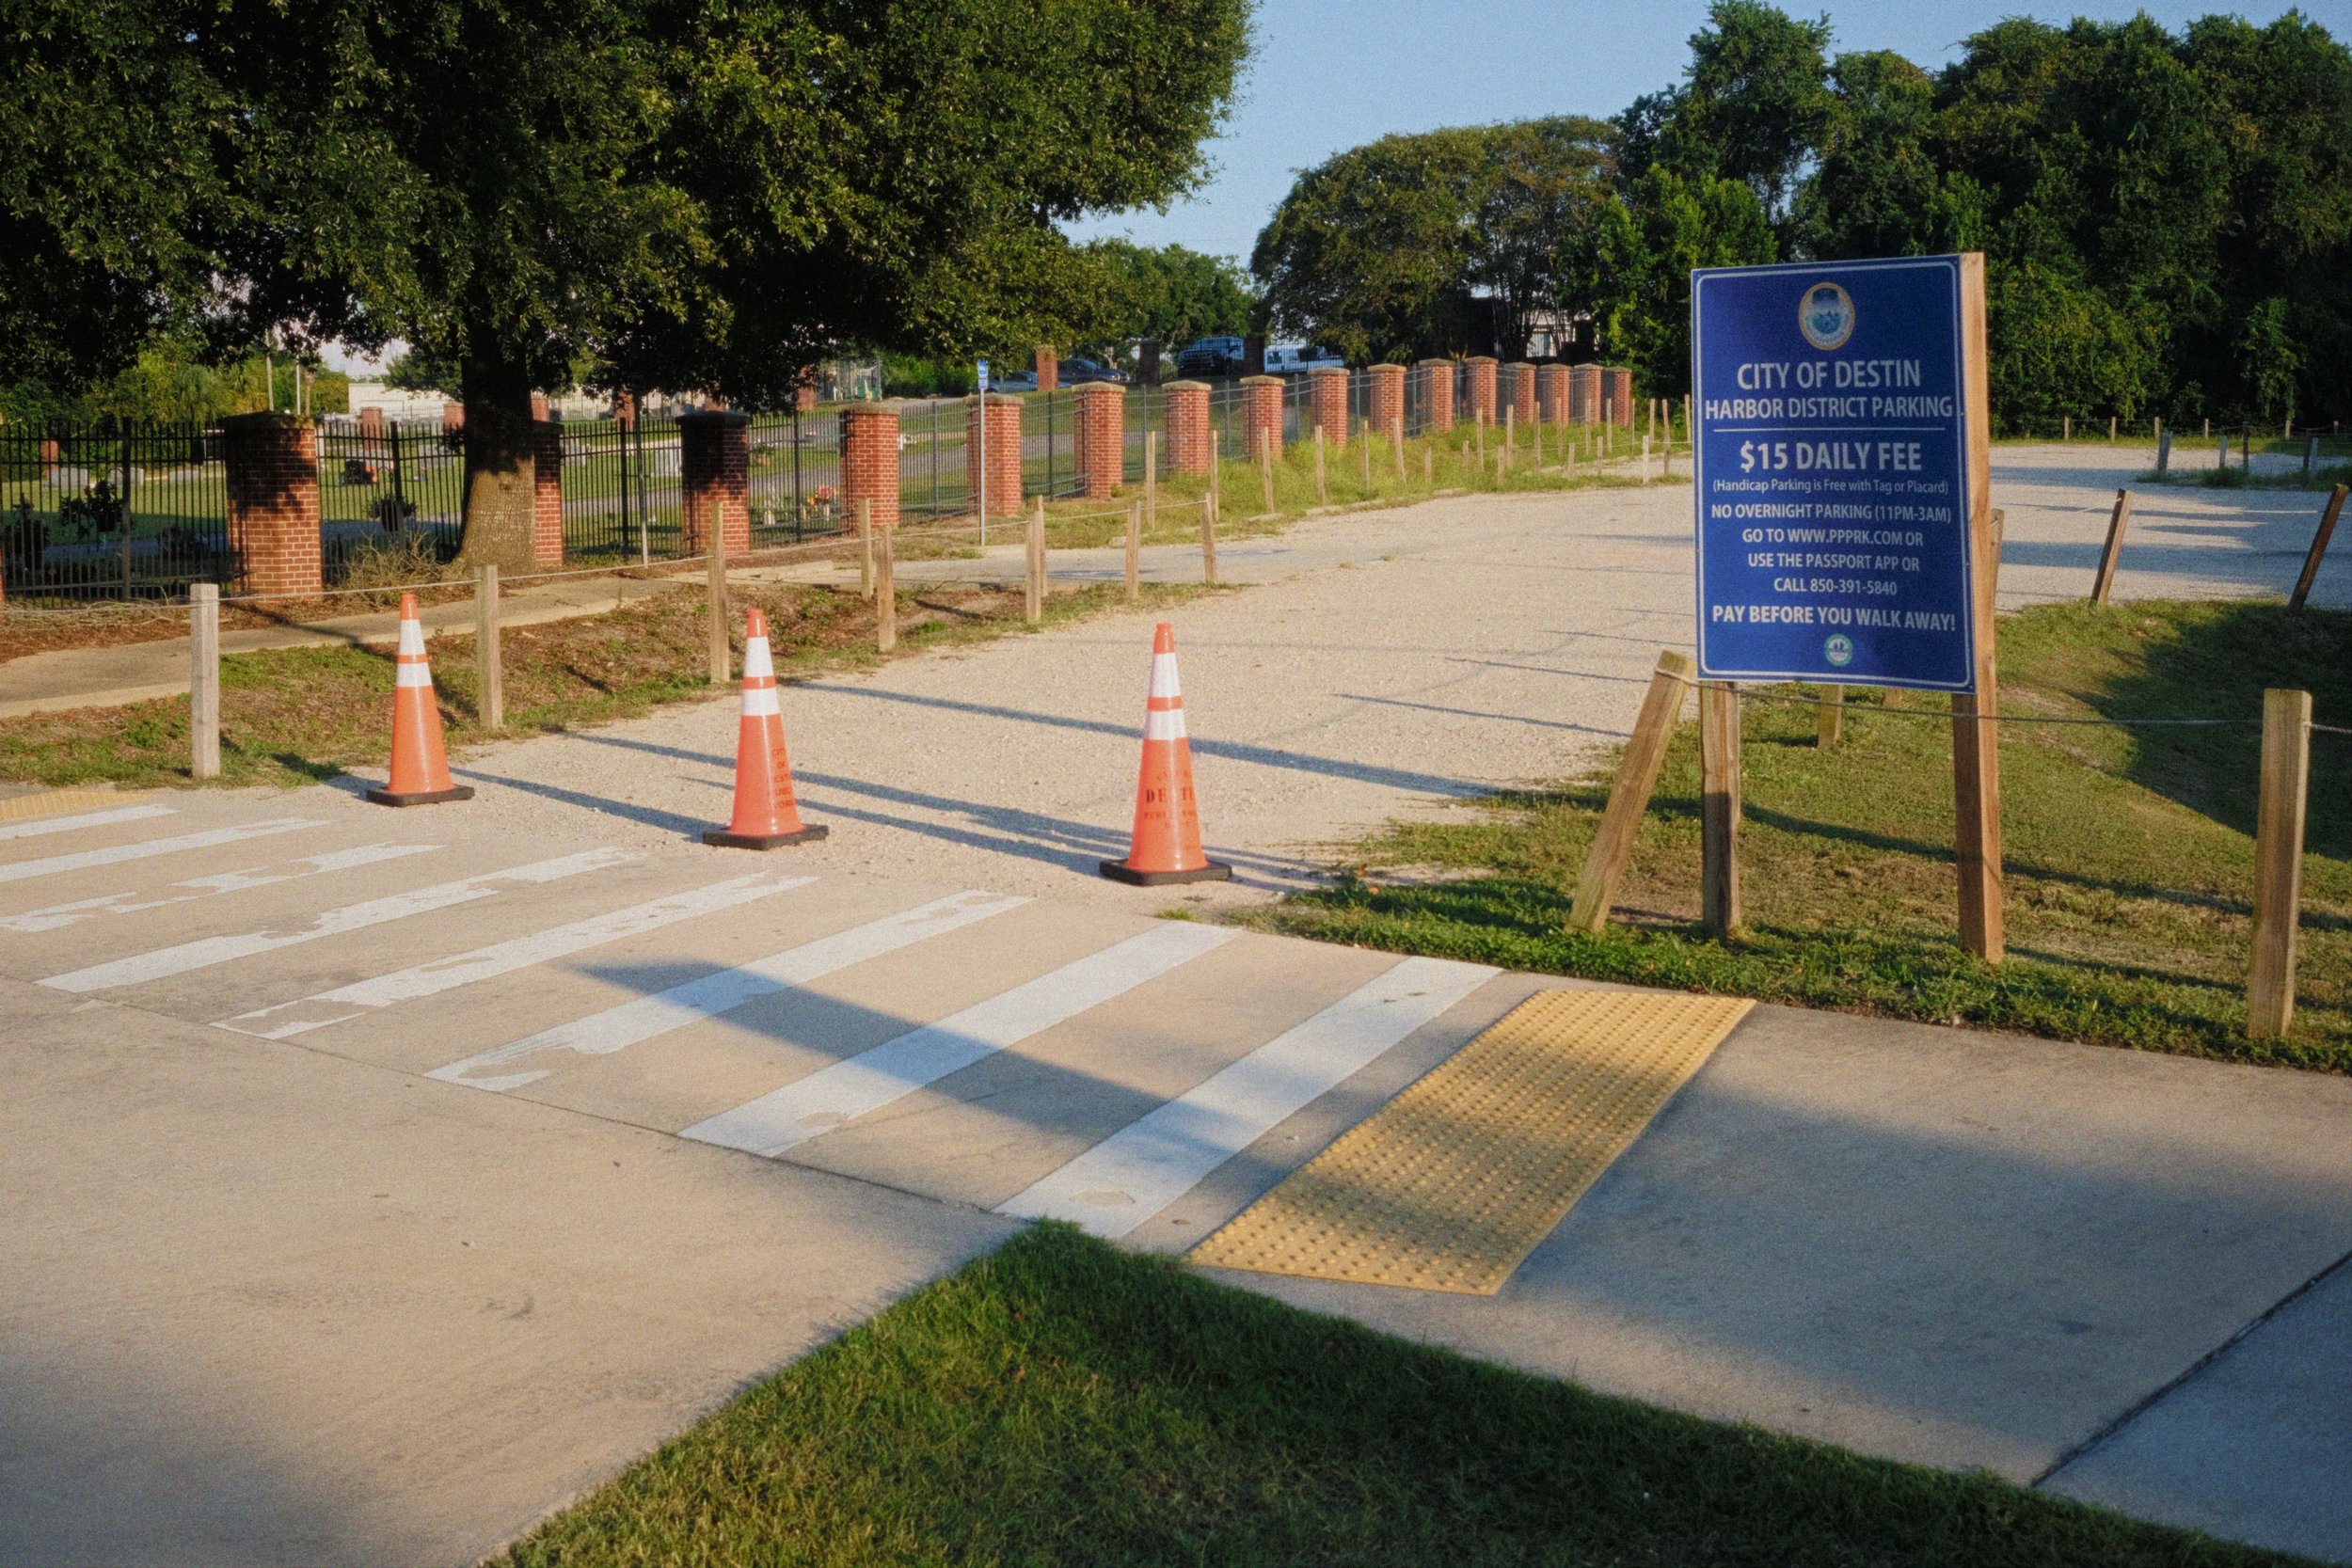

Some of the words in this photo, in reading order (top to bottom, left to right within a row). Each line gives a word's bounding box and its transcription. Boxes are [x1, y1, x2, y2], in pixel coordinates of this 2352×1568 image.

[1737, 362, 1790, 389] CITY
[1796, 361, 1829, 388] OF
[1835, 359, 1921, 388] DESTIN
[1705, 399, 1784, 420] HARBOR
[1788, 397, 1867, 418] DISTRICT
[1872, 396, 1953, 418] PARKING
[1740, 440, 1788, 473] $15
[1796, 442, 1871, 470] DAILY
[1878, 442, 1922, 470] FEE
[1713, 479, 1769, 494] (Handicap
[1771, 479, 1811, 494] Parking
[1813, 479, 1822, 491] is
[1824, 479, 1847, 492] Free
[1849, 479, 1872, 492] with
[1873, 480, 1892, 495] Tag
[1894, 483, 1906, 493] or
[1907, 480, 1949, 495] Placard)
[1711, 504, 1732, 518] NO
[1735, 503, 1813, 519] OVERNIGHT
[1816, 504, 1872, 519] PARKING
[1874, 505, 1952, 524] (11PM-3AM)
[1742, 529, 1763, 543] GO
[1766, 529, 1785, 543] TO
[1787, 529, 1903, 546] WWW.PPPRK.COM
[1905, 531, 1923, 546] OR
[1748, 553, 1774, 567] USE
[1777, 553, 1803, 567] THE
[1805, 554, 1871, 569] PASSPORT
[1874, 555, 1899, 570] APP
[1901, 557, 1920, 571] OR
[1773, 578, 1807, 592] CALL
[1810, 578, 1898, 595] 850-391-5840
[1712, 605, 1745, 623] PAY
[1749, 606, 1814, 624] BEFORE
[1818, 607, 1851, 626] YOU
[1855, 608, 1901, 627] WALK
[1904, 611, 1956, 631] AWAY!
